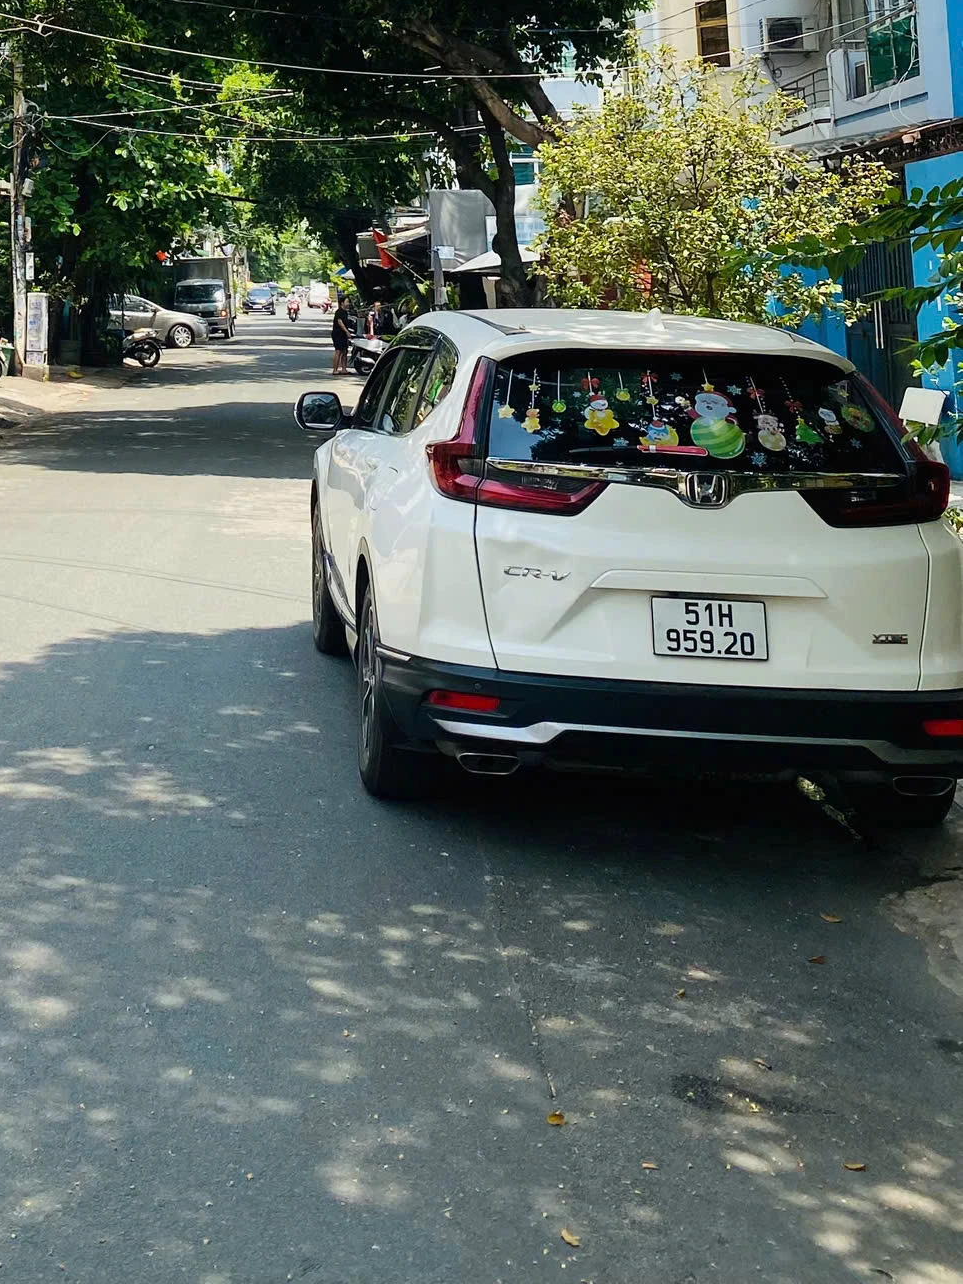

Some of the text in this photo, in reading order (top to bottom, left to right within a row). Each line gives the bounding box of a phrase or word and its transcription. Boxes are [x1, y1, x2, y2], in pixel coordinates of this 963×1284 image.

[503, 565, 572, 581] CR-V
[684, 601, 734, 627] 51H
[666, 628, 756, 656] 959.20
